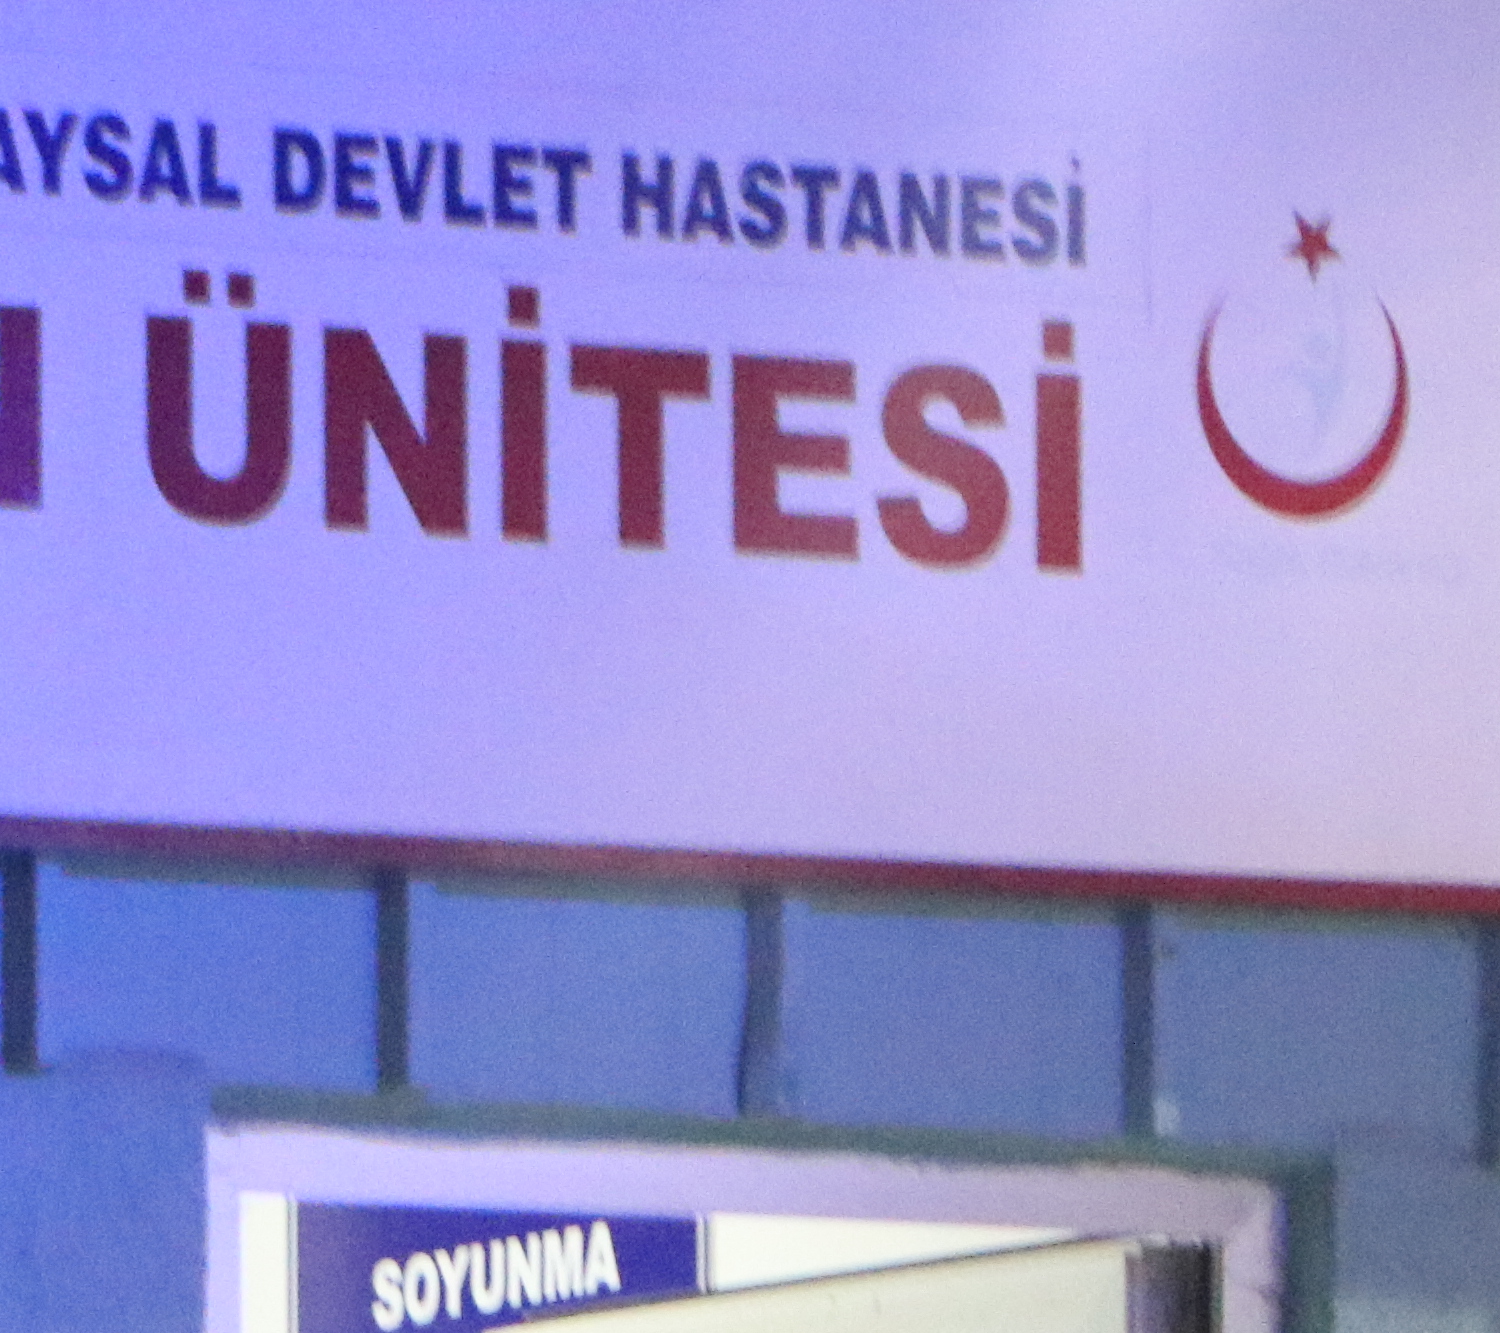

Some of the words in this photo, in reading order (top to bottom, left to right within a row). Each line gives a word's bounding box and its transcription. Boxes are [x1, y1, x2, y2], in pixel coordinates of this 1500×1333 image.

[269, 122, 594, 232] DEVLET
[618, 148, 1087, 267] HASTANESİ
[142, 265, 1085, 574] ÜNİTESİ
[370, 1219, 622, 1333] SOYUNMA
